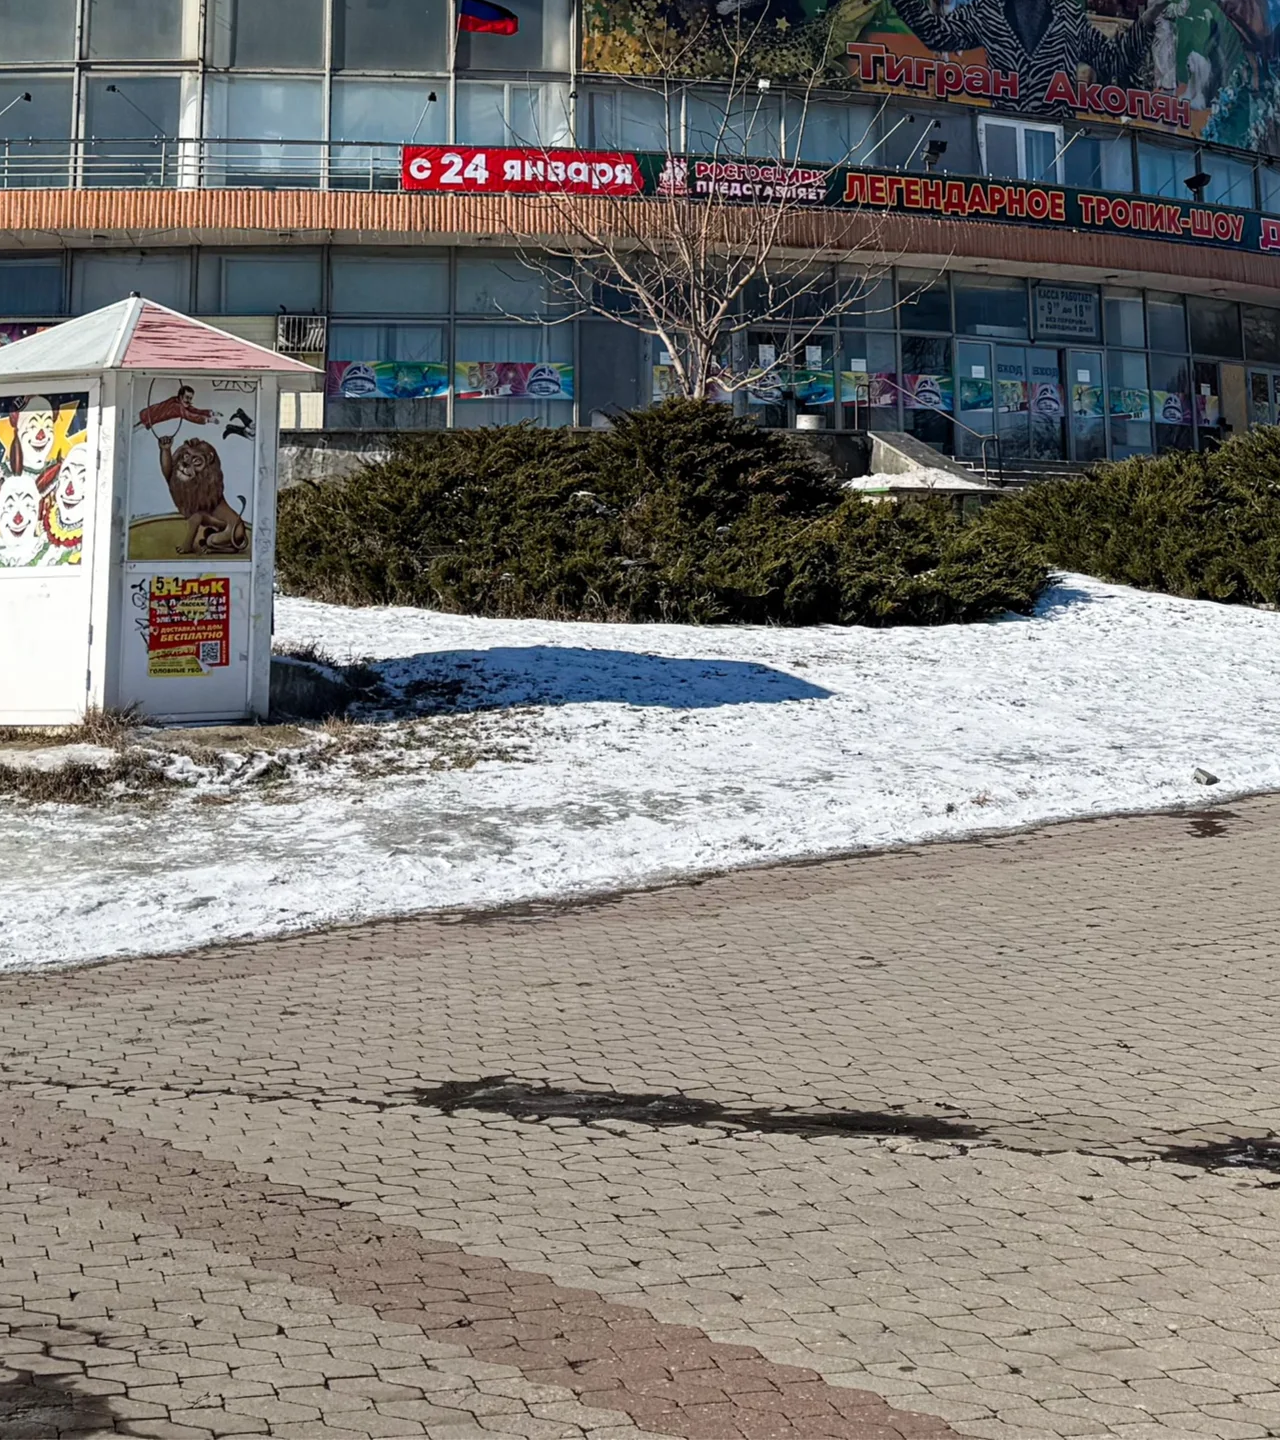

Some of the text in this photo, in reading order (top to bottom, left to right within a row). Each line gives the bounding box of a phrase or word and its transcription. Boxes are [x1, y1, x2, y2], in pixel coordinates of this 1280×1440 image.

[846, 42, 1192, 127] Тигран Акопян
[409, 152, 632, 189] с 24 января
[695, 161, 827, 186] РОСГОСЦИРК
[696, 180, 827, 200] ПРЕДСТАВЛЯЕТ
[843, 172, 1066, 221] ЛЕГЕНДАРНОЕ
[1078, 194, 1245, 242] ТРОПИК-ШОУ
[1038, 289, 1093, 303] КАССА РАБОТАЕТ
[997, 363, 1024, 377] ВХОД
[160, 631, 224, 642] БЕСПЛАТНО
